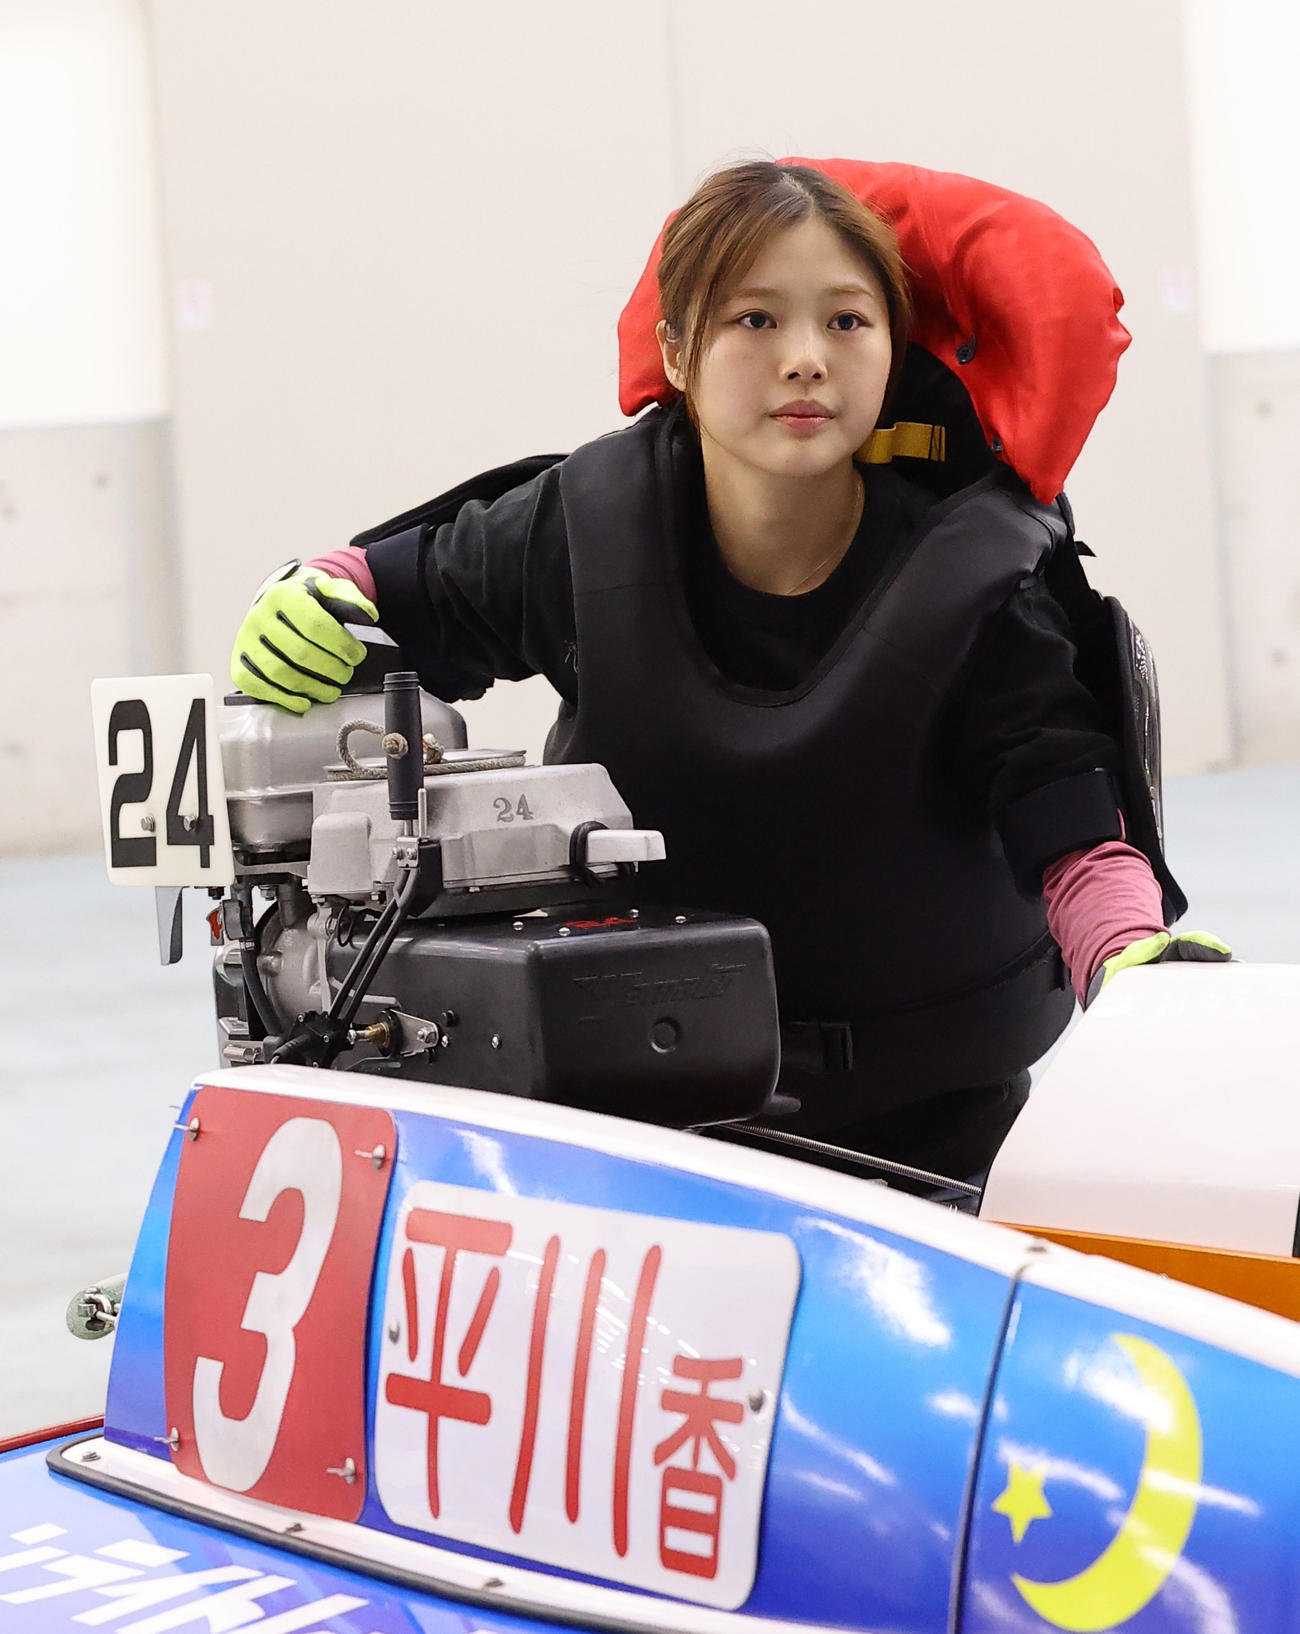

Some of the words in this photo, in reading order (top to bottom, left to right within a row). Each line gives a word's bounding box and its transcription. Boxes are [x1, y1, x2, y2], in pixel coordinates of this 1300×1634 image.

[108, 698, 215, 869] 24
[493, 793, 534, 823] 24
[193, 1117, 342, 1492] 3
[385, 1208, 744, 1581] 平川香
